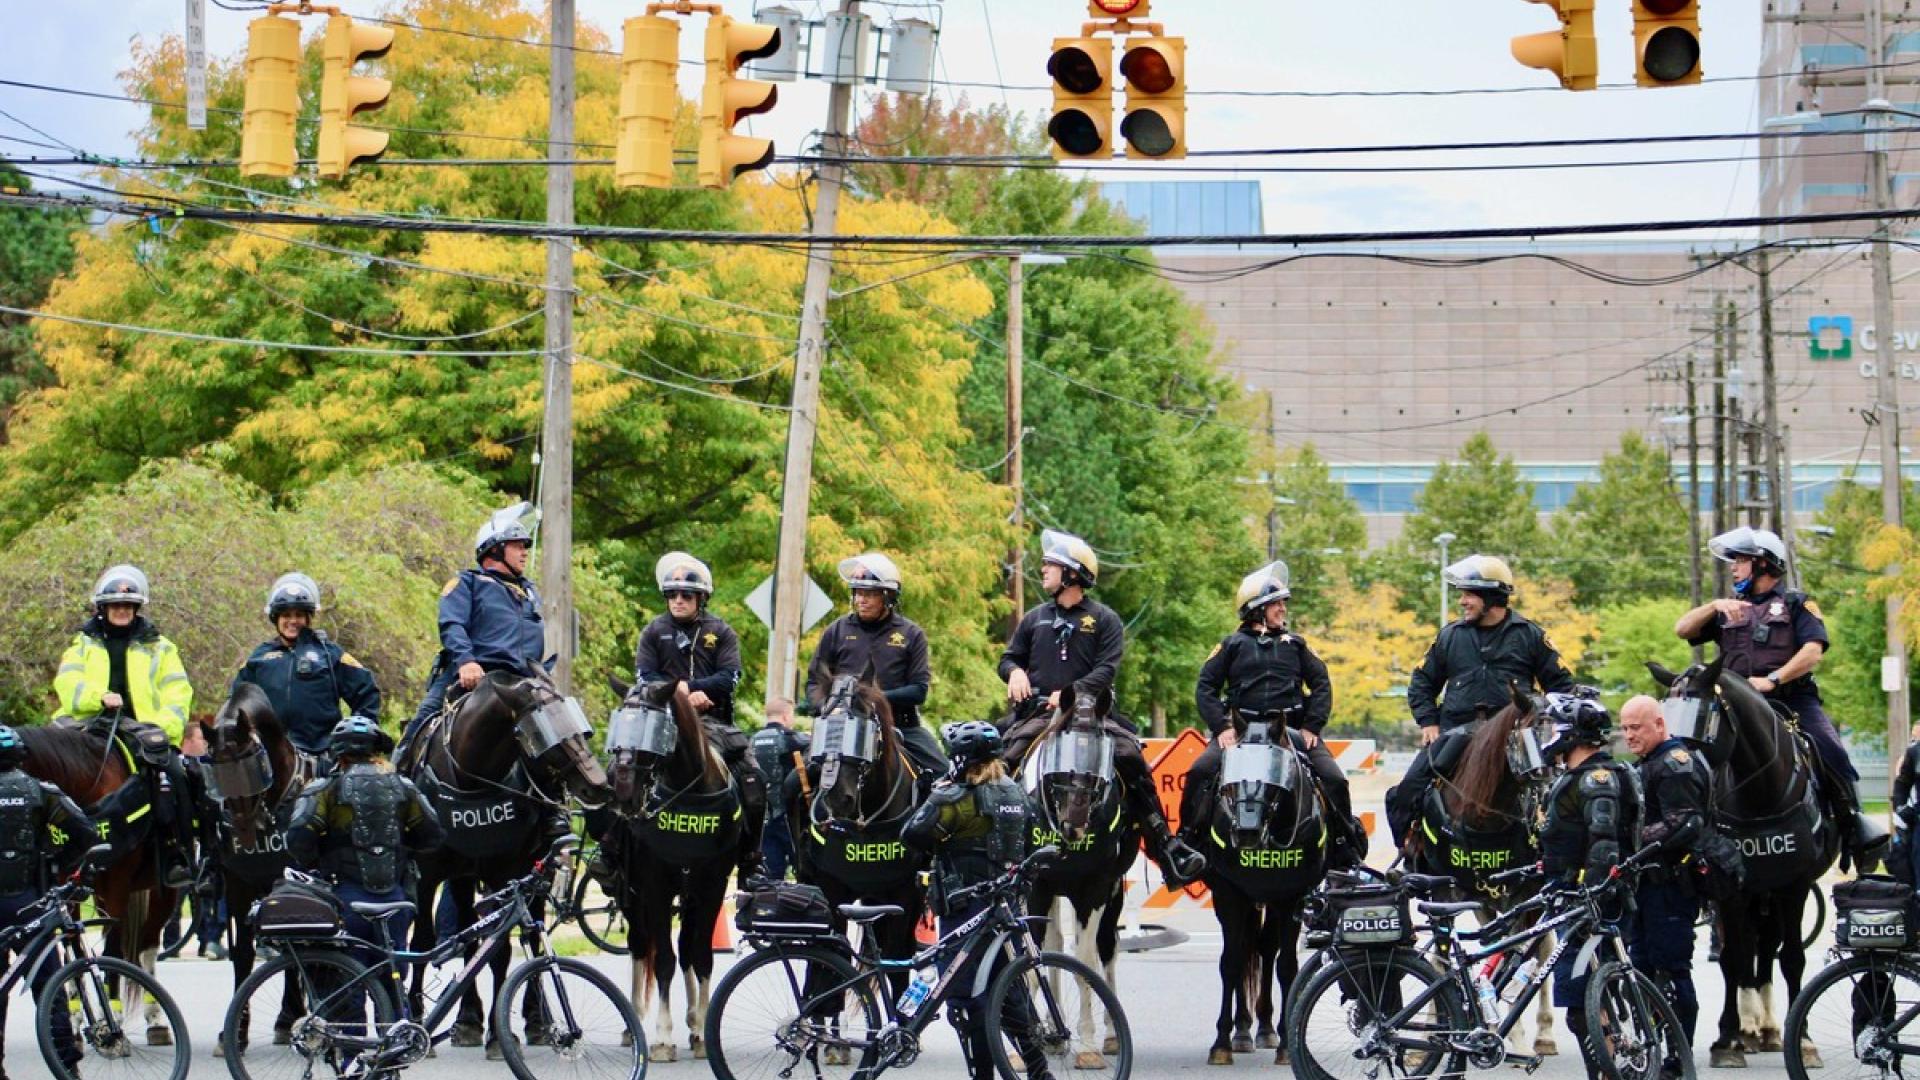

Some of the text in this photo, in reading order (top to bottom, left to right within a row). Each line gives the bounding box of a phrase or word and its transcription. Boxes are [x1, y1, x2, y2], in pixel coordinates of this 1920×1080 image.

[452, 801, 515, 829] POLICE
[657, 811, 721, 834] SHERIFF
[232, 830, 289, 855] PLIC
[1239, 848, 1304, 869] SHERIFF
[1343, 918, 1401, 932] POLICE
[1850, 924, 1905, 936] POLICE
